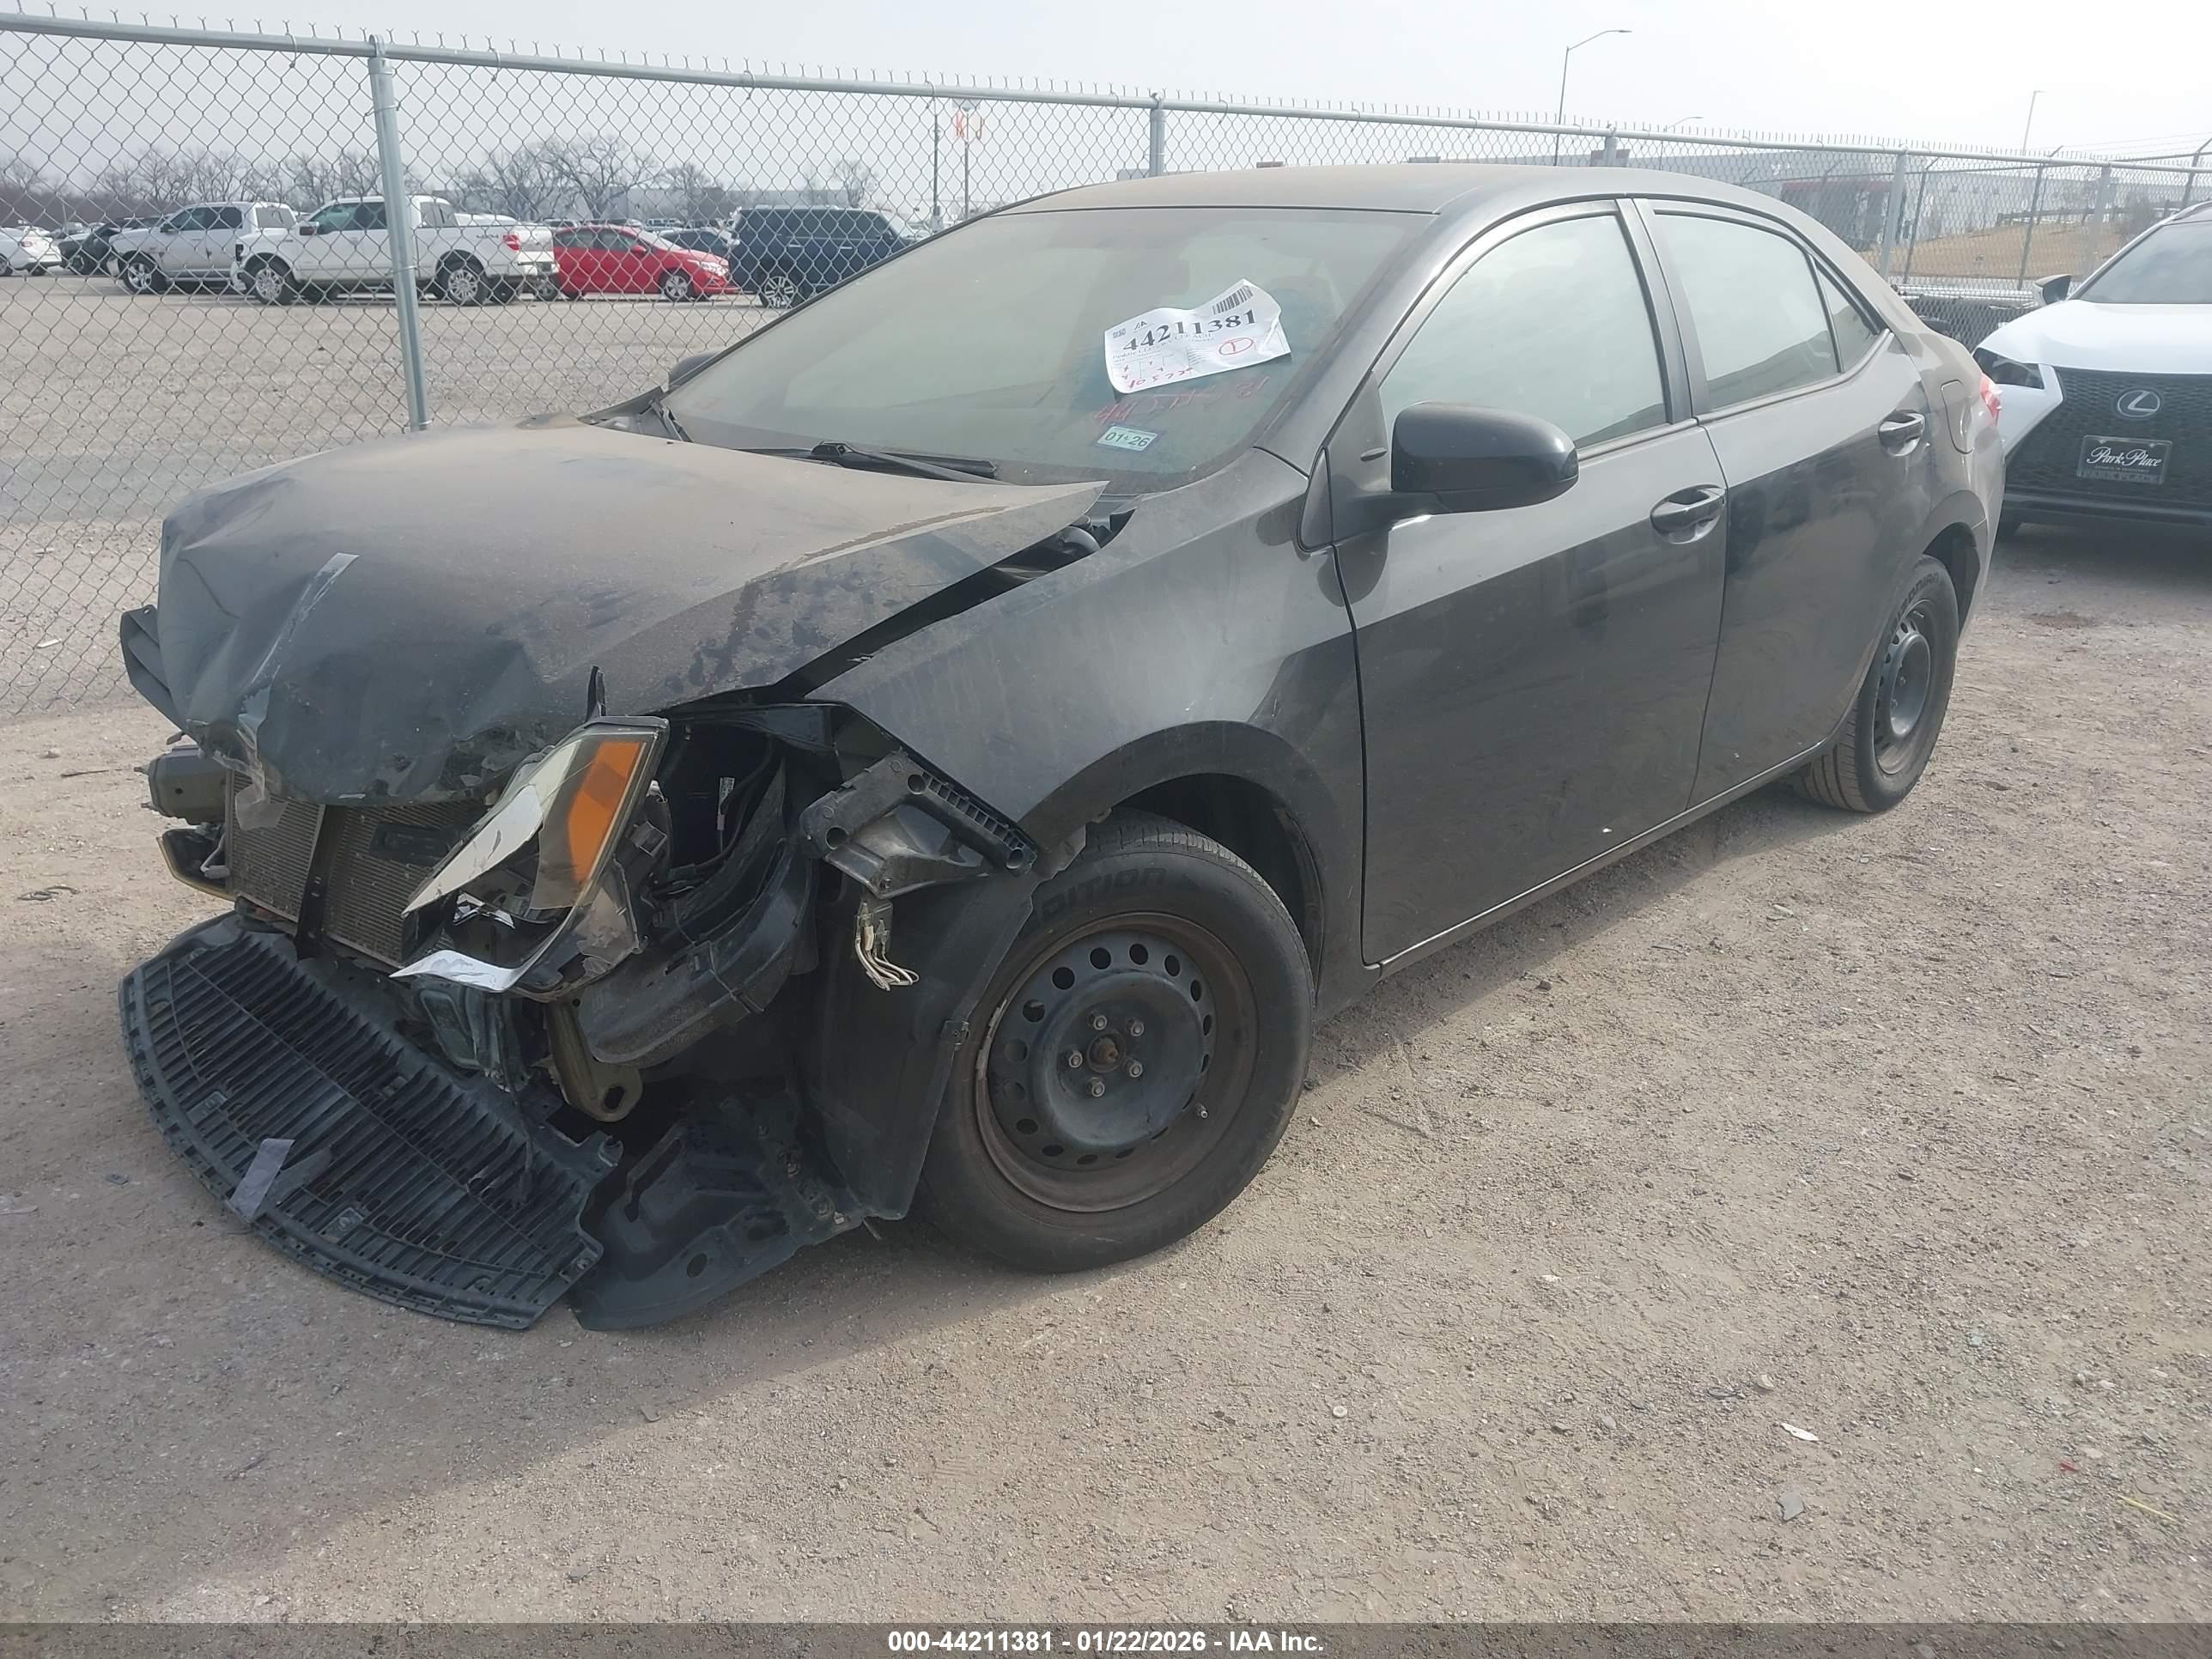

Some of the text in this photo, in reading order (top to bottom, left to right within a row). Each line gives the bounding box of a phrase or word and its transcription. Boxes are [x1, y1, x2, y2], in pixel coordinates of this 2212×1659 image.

[1122, 308, 1256, 350] 44211381
[2086, 446, 2162, 467] Park Place
